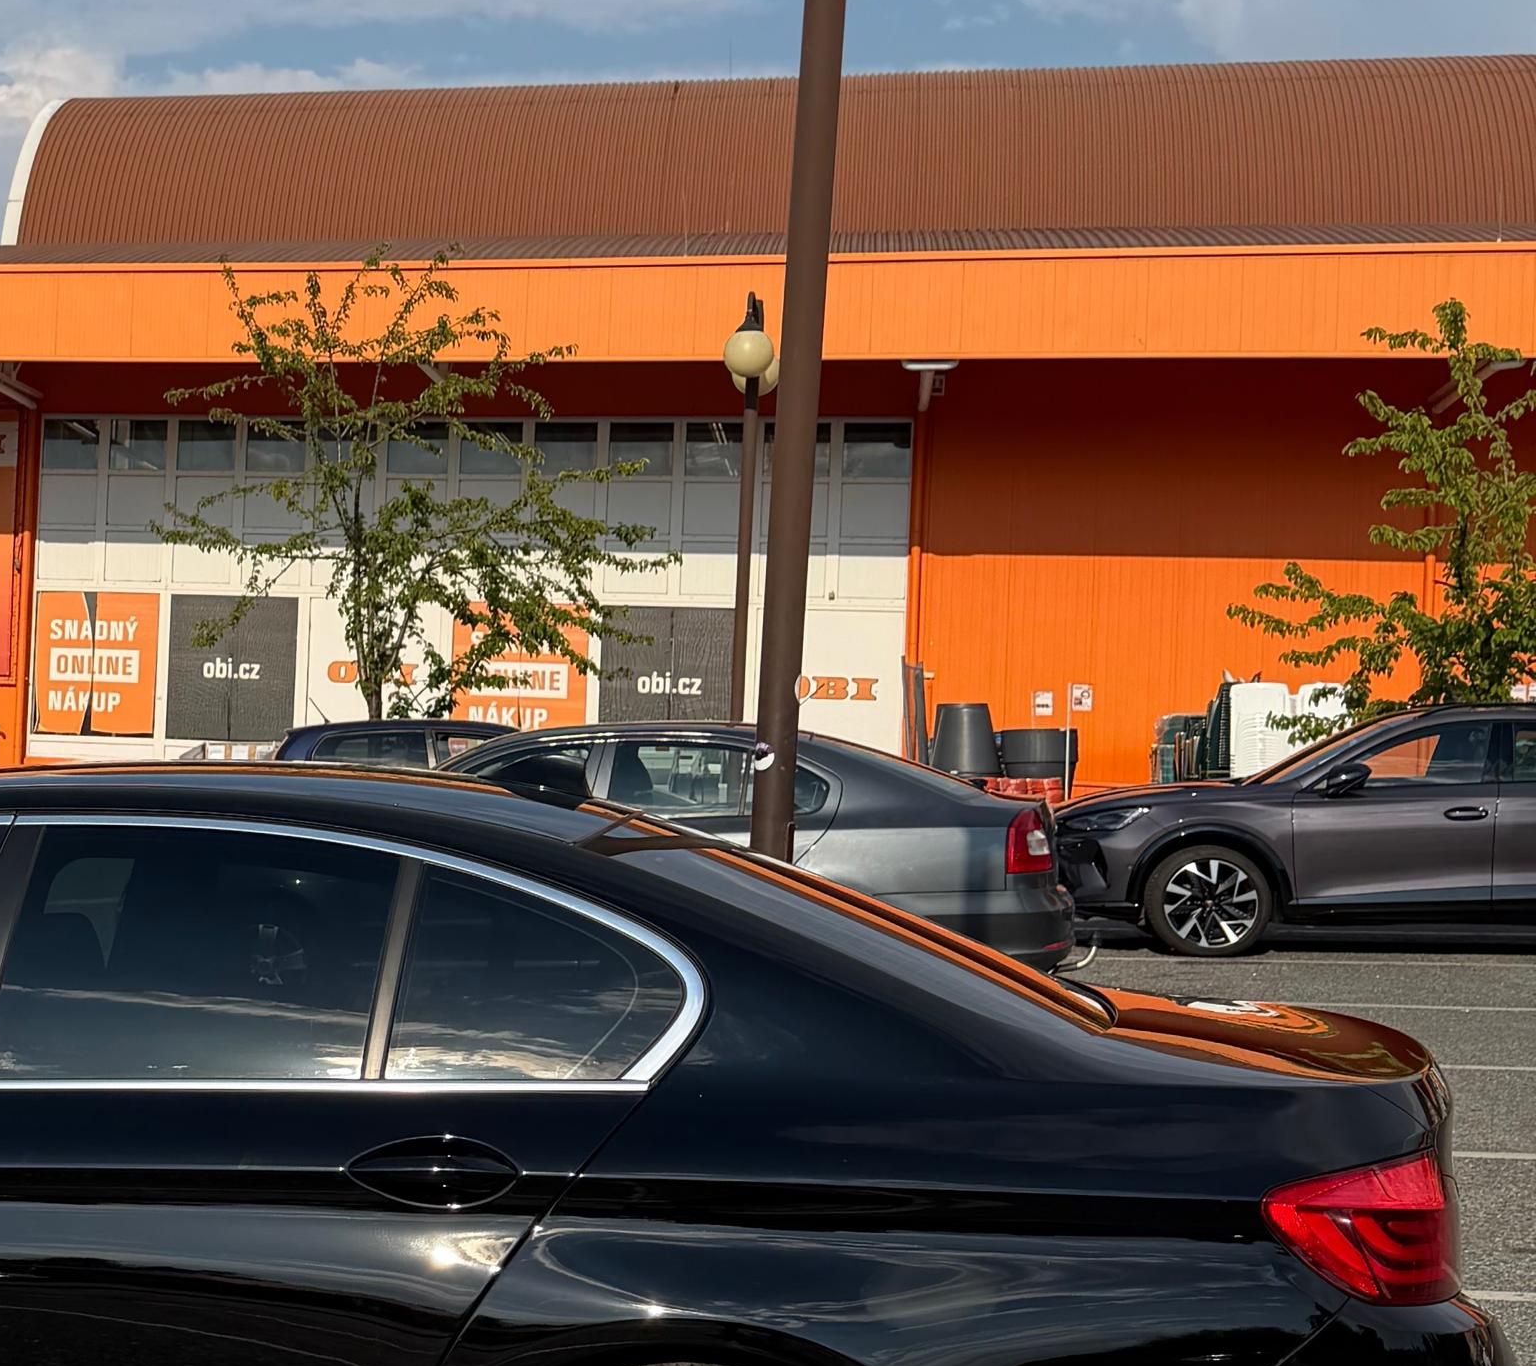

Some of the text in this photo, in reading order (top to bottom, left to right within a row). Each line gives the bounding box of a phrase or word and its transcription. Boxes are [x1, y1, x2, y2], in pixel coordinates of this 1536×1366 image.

[49, 616, 139, 642] SNADNÝ
[56, 654, 133, 676] ONLINE
[202, 657, 261, 680] obi.cz
[637, 671, 703, 695] obi.cz
[48, 685, 122, 713] NÁKUP
[468, 700, 549, 733] NÁKUP
